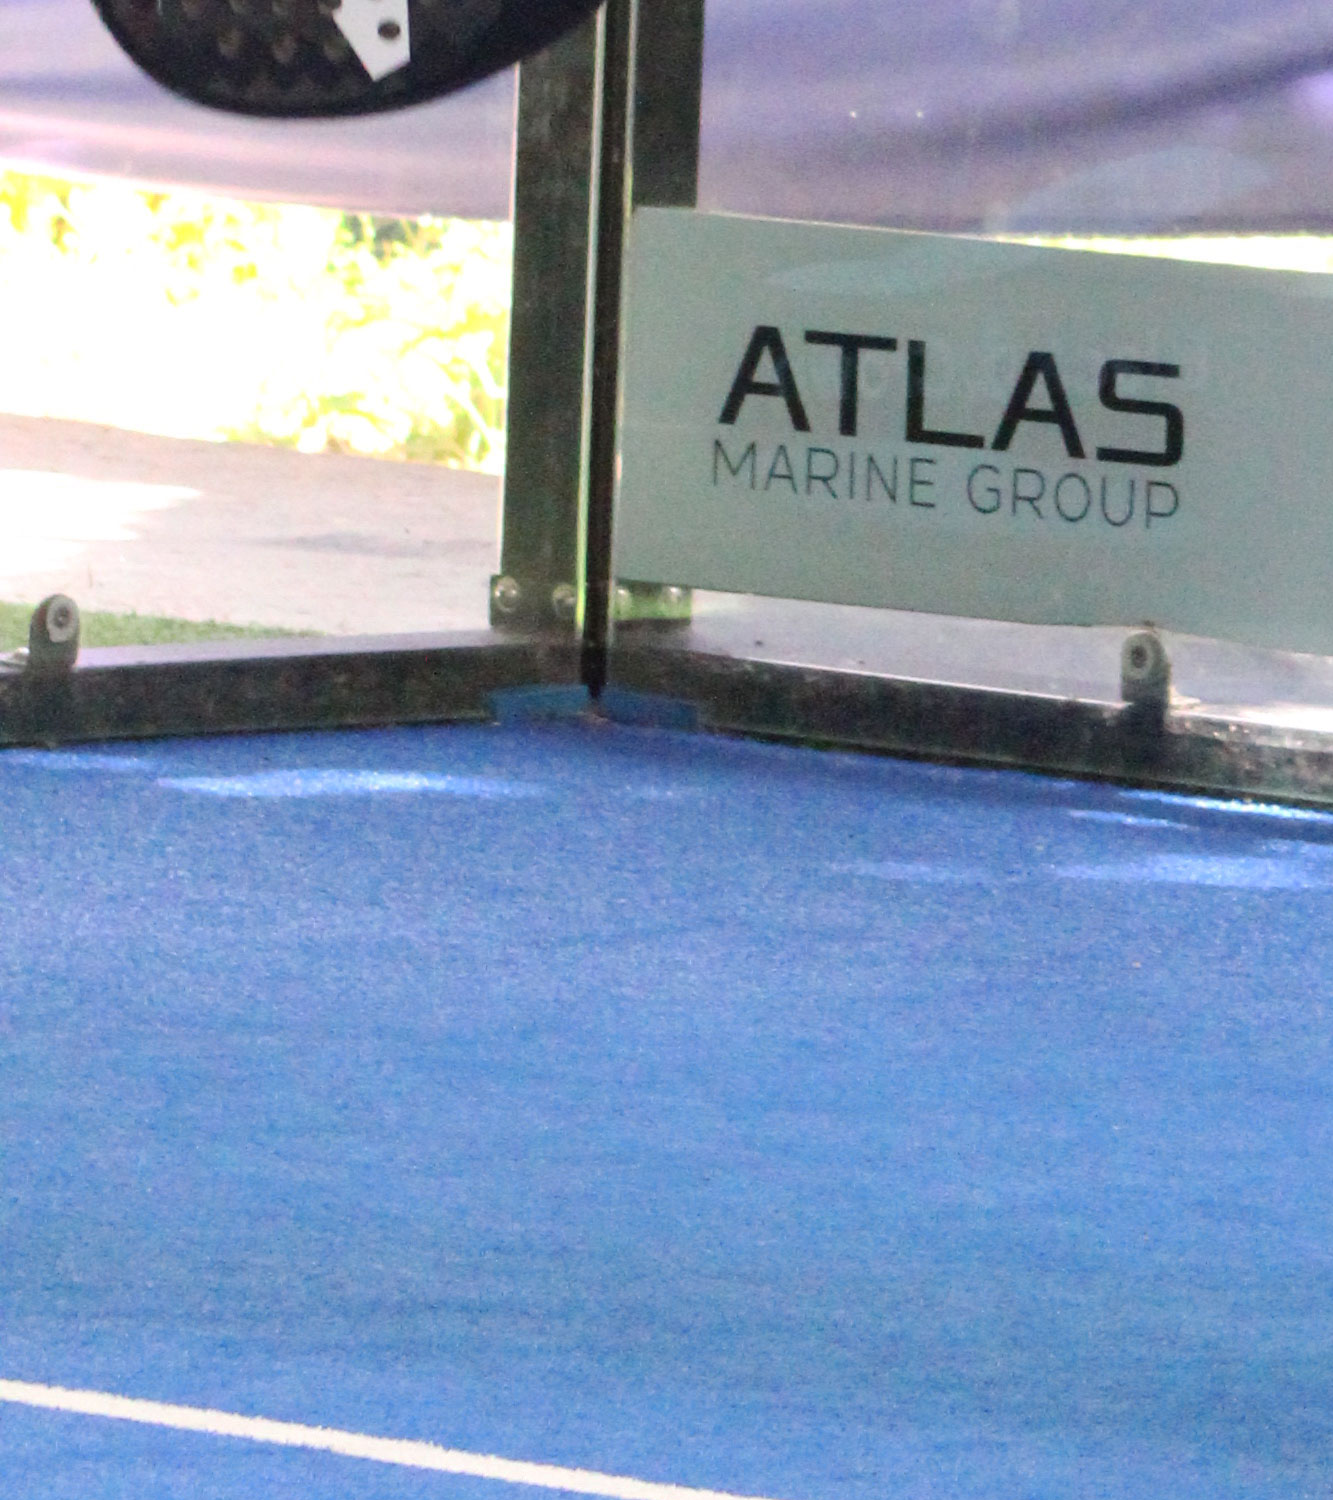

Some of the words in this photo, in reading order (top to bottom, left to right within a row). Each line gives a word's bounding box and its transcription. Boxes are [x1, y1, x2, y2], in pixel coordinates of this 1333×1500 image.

[718, 326, 1185, 467] ATLAS
[713, 438, 937, 509] MARINE
[967, 464, 1180, 529] GROUP
